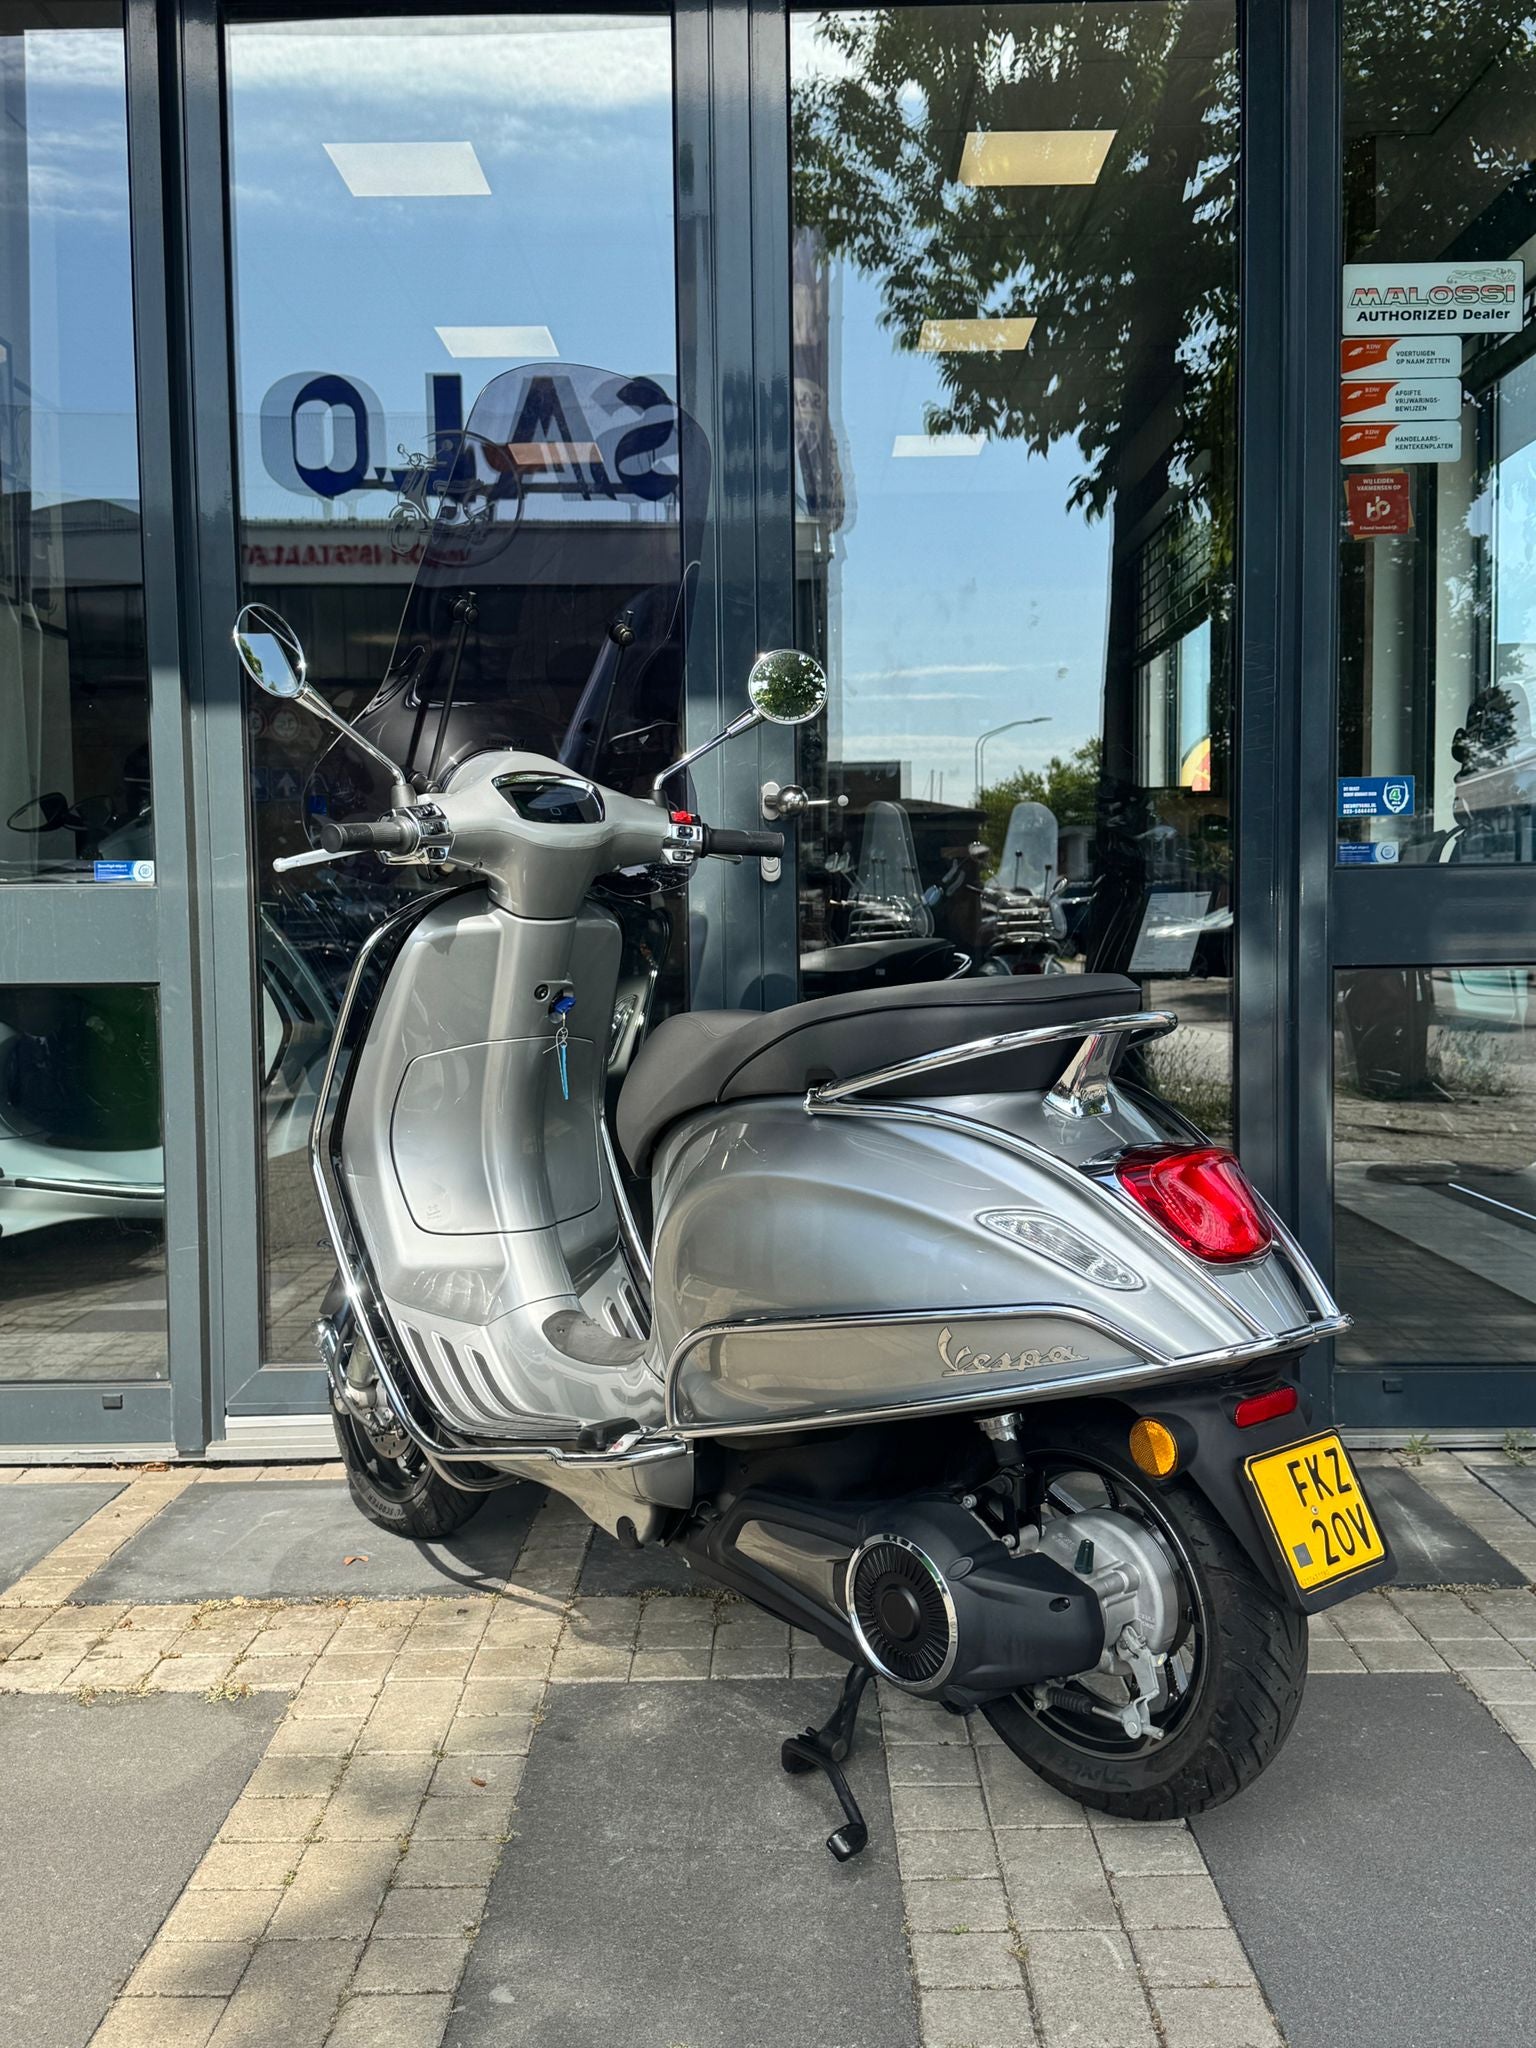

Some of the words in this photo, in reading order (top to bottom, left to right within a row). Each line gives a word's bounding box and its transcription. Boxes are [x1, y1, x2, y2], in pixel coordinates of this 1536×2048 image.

[1349, 285, 1516, 307] MALOSSI
[1356, 310, 1458, 322] AUTHORIZED
[1463, 308, 1511, 320] Dealer
[937, 1325, 1090, 1378] Vespa
[1286, 1447, 1353, 1508] FKZ
[1311, 1503, 1372, 1566] 20V
